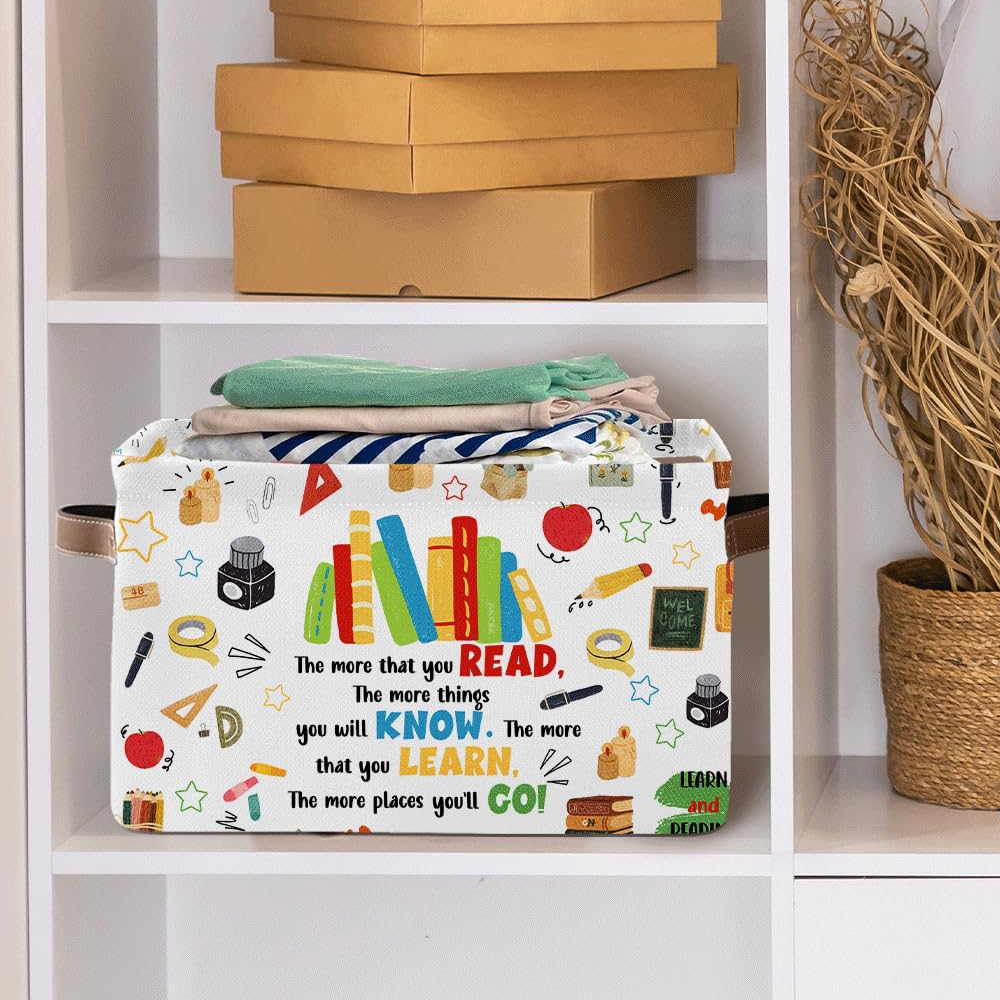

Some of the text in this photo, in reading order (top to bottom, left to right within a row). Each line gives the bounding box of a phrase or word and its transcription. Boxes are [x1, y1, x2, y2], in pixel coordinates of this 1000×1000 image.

[663, 597, 695, 613] WEL
[294, 643, 565, 683] The more that you READ,
[352, 685, 490, 711] The more things
[296, 709, 582, 746] you will KNOW. The more
[315, 746, 519, 783] that you LEARN,
[680, 771, 728, 788] LEARN
[287, 783, 548, 819] The more places you'll GO!
[687, 796, 719, 813] and
